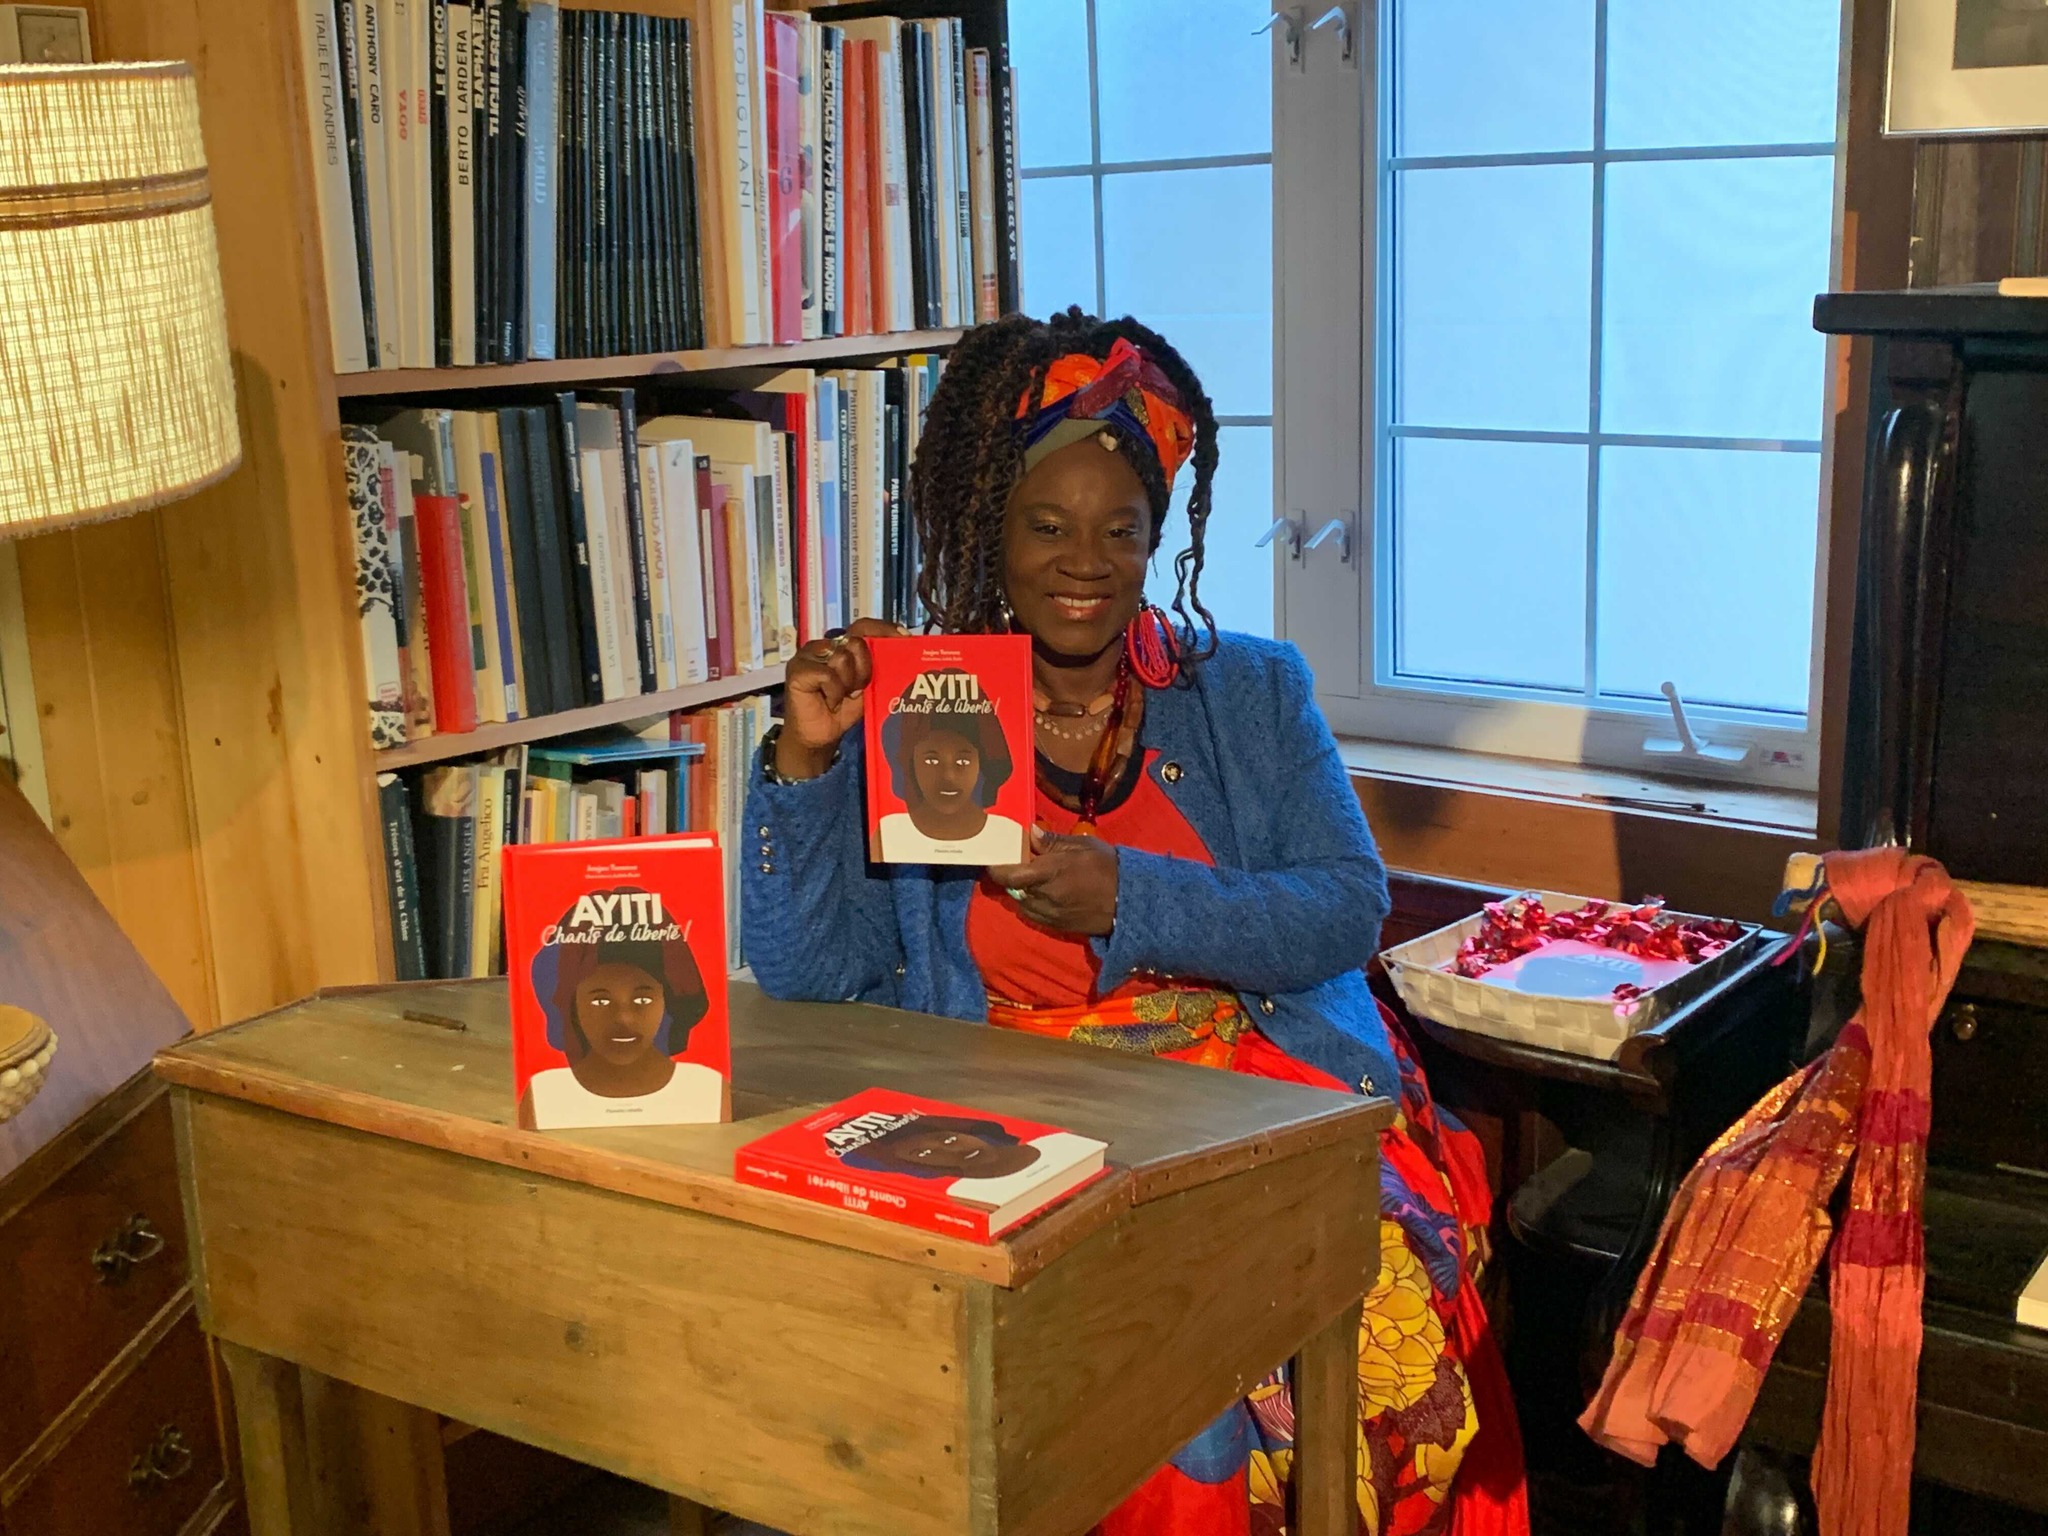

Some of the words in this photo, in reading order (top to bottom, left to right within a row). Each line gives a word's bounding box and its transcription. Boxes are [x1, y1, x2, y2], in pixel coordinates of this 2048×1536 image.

[315, 12, 329, 57] ITALIE
[365, 4, 378, 77] ANTHONY
[434, 5, 446, 70] GRECO
[319, 62, 331, 81] ET
[435, 74, 447, 96] LE
[456, 29, 468, 114] LARDERA
[369, 83, 381, 124] CARO
[733, 20, 751, 209] MODIGLIANI
[823, 49, 835, 142] SPECTACLES
[322, 86, 338, 166] FLANDRES
[398, 89, 409, 141] GOYA
[456, 126, 469, 186] BERTO
[1003, 86, 1016, 262] MADEMOISELLE
[824, 190, 836, 231] DANS
[824, 233, 836, 253] LE
[824, 257, 836, 312] MONDE
[849, 388, 859, 442] Painting
[850, 444, 858, 492] Western
[890, 478, 899, 501] PAUL
[851, 493, 859, 553] Character
[654, 540, 665, 580] ROMY
[852, 555, 860, 599] Studies
[910, 673, 979, 700] AYITI
[888, 697, 934, 715] Chants
[935, 699, 951, 714] de
[388, 821, 402, 857] Trésors
[477, 797, 493, 863] Angelico
[393, 859, 404, 883] d'art
[477, 866, 489, 890] Fra
[396, 885, 405, 899] de
[398, 900, 407, 911] la
[570, 893, 663, 927] AYITI
[399, 912, 410, 942] Chine
[541, 924, 602, 947] Chants
[605, 924, 627, 943] de
[823, 1111, 896, 1146] AYITI
[868, 1129, 886, 1138] de
[844, 1196, 869, 1211] AYITI
[853, 1184, 866, 1196] de
[870, 1188, 906, 1208] Chants
